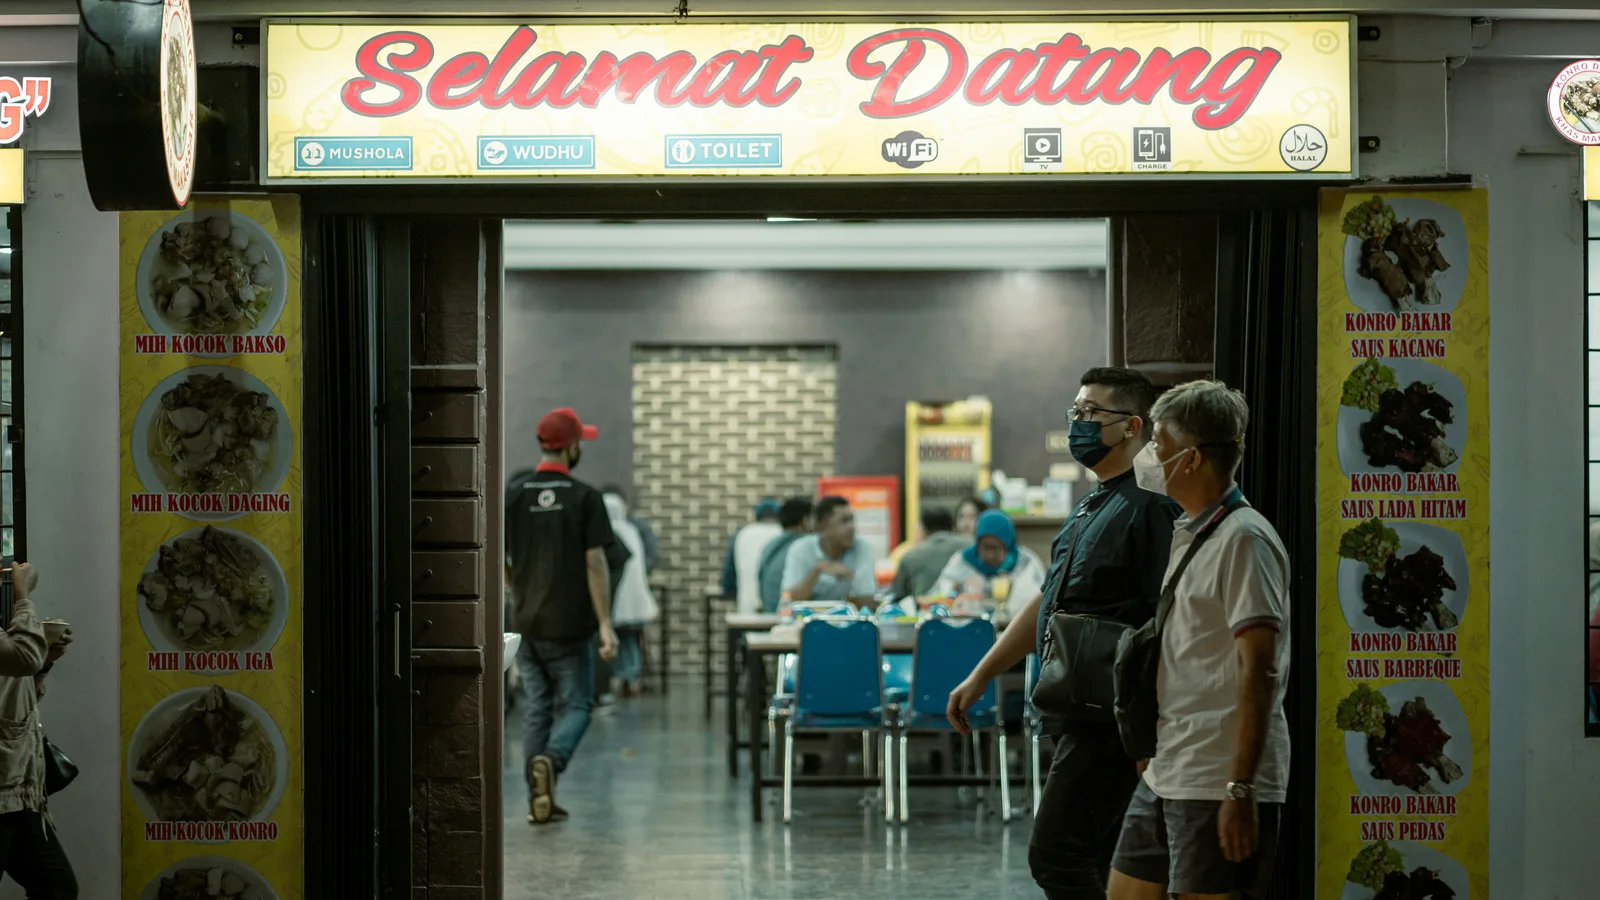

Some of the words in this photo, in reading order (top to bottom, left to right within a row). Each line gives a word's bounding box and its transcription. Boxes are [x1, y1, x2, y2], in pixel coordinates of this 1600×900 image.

[341, 25, 814, 118] Selamat
[847, 27, 1282, 131] Datang
[1555, 62, 1588, 88] KONRO
[1592, 62, 1600, 70] D
[1555, 116, 1579, 139] KHAS
[1581, 134, 1600, 142] MA
[699, 142, 773, 159] TOILET
[1285, 130, 1323, 153] حلال
[329, 147, 405, 160] MUSHOLA
[512, 145, 584, 160] WUDHU
[1345, 313, 1396, 331] KONRO
[1401, 313, 1452, 331] BAKAR
[135, 335, 166, 353] MIH
[171, 335, 227, 353] KOCOK
[232, 335, 287, 353] BAKSO
[1351, 339, 1384, 357] SAUS
[1389, 339, 1445, 357] KACANG
[1351, 474, 1401, 492] KONRO
[1407, 474, 1457, 492] BAKAR
[131, 494, 162, 512] MIH
[167, 494, 223, 512] KOCOK
[228, 494, 290, 512] DAGING
[1341, 499, 1374, 518] SAUS
[1379, 499, 1416, 518] LADA
[1421, 499, 1467, 518] HITAM
[1351, 633, 1401, 651] KONRO
[1407, 633, 1457, 651] BAKAR
[148, 652, 179, 671] MIH
[184, 652, 240, 671] KOCOK
[245, 652, 274, 671] IGA
[1346, 659, 1379, 678] SAUS
[1384, 659, 1461, 680] BARBEQUE
[1350, 796, 1401, 814] KONRO
[1406, 796, 1456, 814] BAKAR
[145, 822, 172, 841] MIH
[176, 822, 223, 841] KOCOK
[229, 822, 278, 841] KONRO
[1361, 822, 1394, 841] SAUS
[1399, 822, 1445, 841] PEDAS
